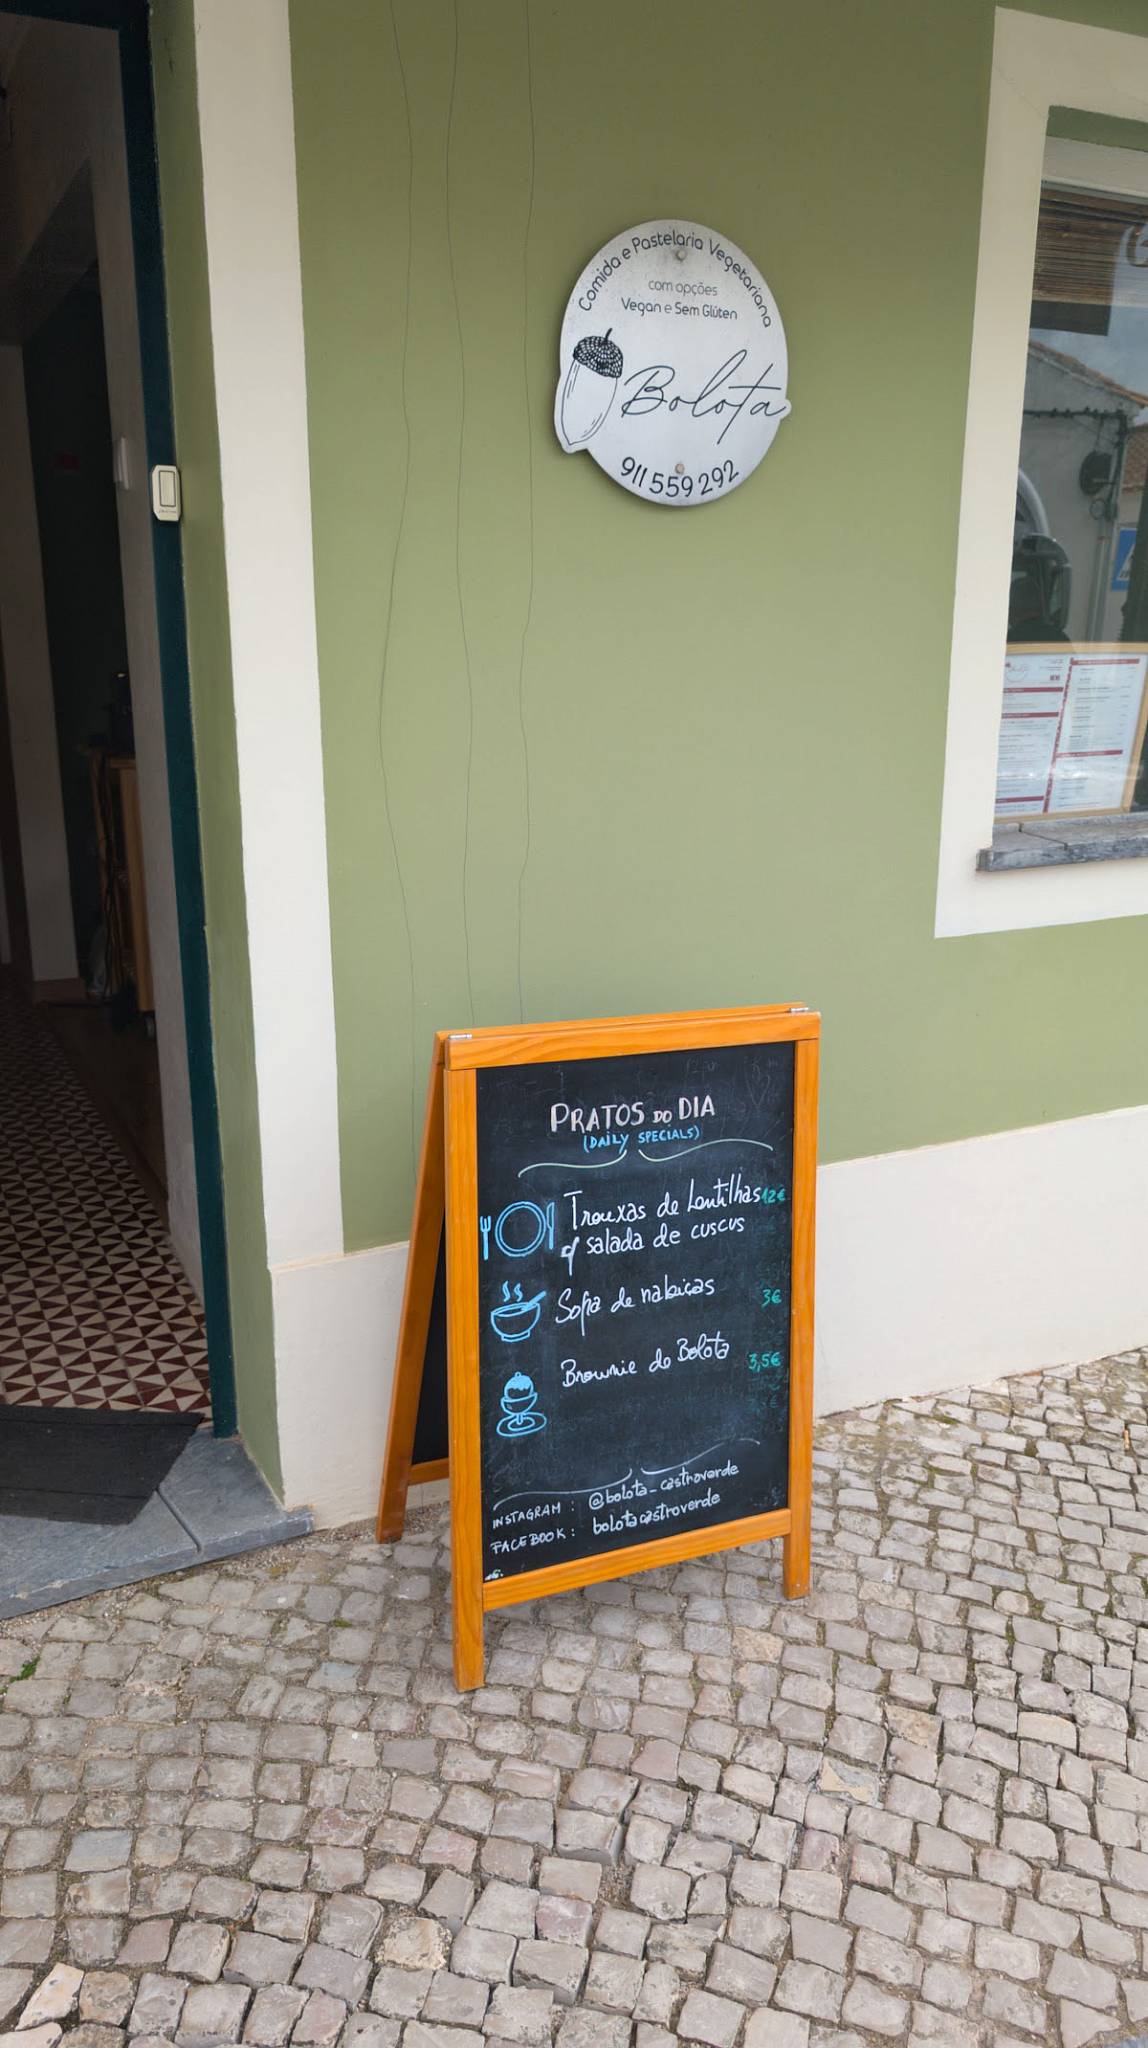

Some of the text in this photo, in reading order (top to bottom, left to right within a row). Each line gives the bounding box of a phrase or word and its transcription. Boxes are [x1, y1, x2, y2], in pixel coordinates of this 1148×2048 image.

[578, 230, 771, 328] Comida e Pastelaria Vegetariana
[649, 280, 718, 297] com opções
[621, 297, 738, 320] Vegan e Sem Glúten
[621, 349, 787, 445] Bolota
[621, 456, 740, 498] 911 559 292
[550, 1094, 716, 1134] PRATOS DO DIA
[563, 1190, 646, 1230] Trouxas
[656, 1192, 679, 1218] de
[761, 1188, 786, 1203] 12€
[587, 1227, 645, 1254] salada
[653, 1223, 681, 1248] de
[691, 1217, 745, 1239] cuscus
[555, 1287, 601, 1336] Sopa
[611, 1287, 636, 1313] de
[761, 1289, 783, 1308] 3€
[561, 1358, 637, 1387] Brownie
[649, 1348, 672, 1373] de
[677, 1331, 730, 1362] Bolota
